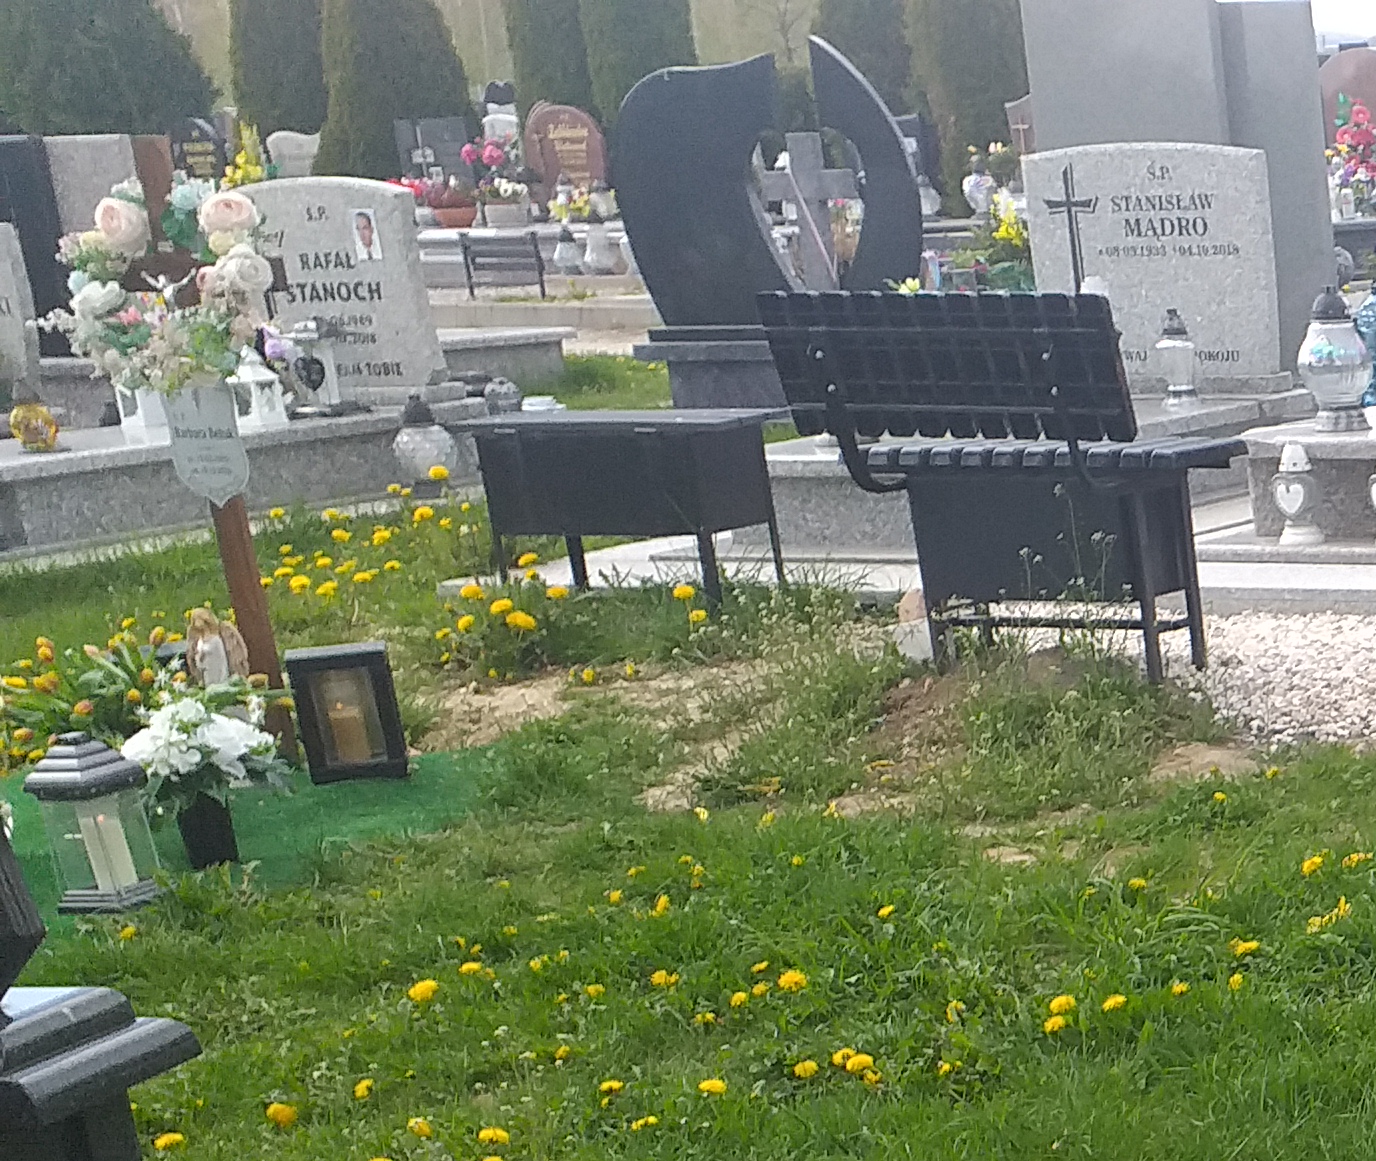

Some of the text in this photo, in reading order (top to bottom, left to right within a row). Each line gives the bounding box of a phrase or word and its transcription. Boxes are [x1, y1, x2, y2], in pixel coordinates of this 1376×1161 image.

[1110, 193, 1215, 214] STANISŁAW
[1124, 216, 1209, 242] MĄDRO
[286, 279, 382, 305] STANOCH
